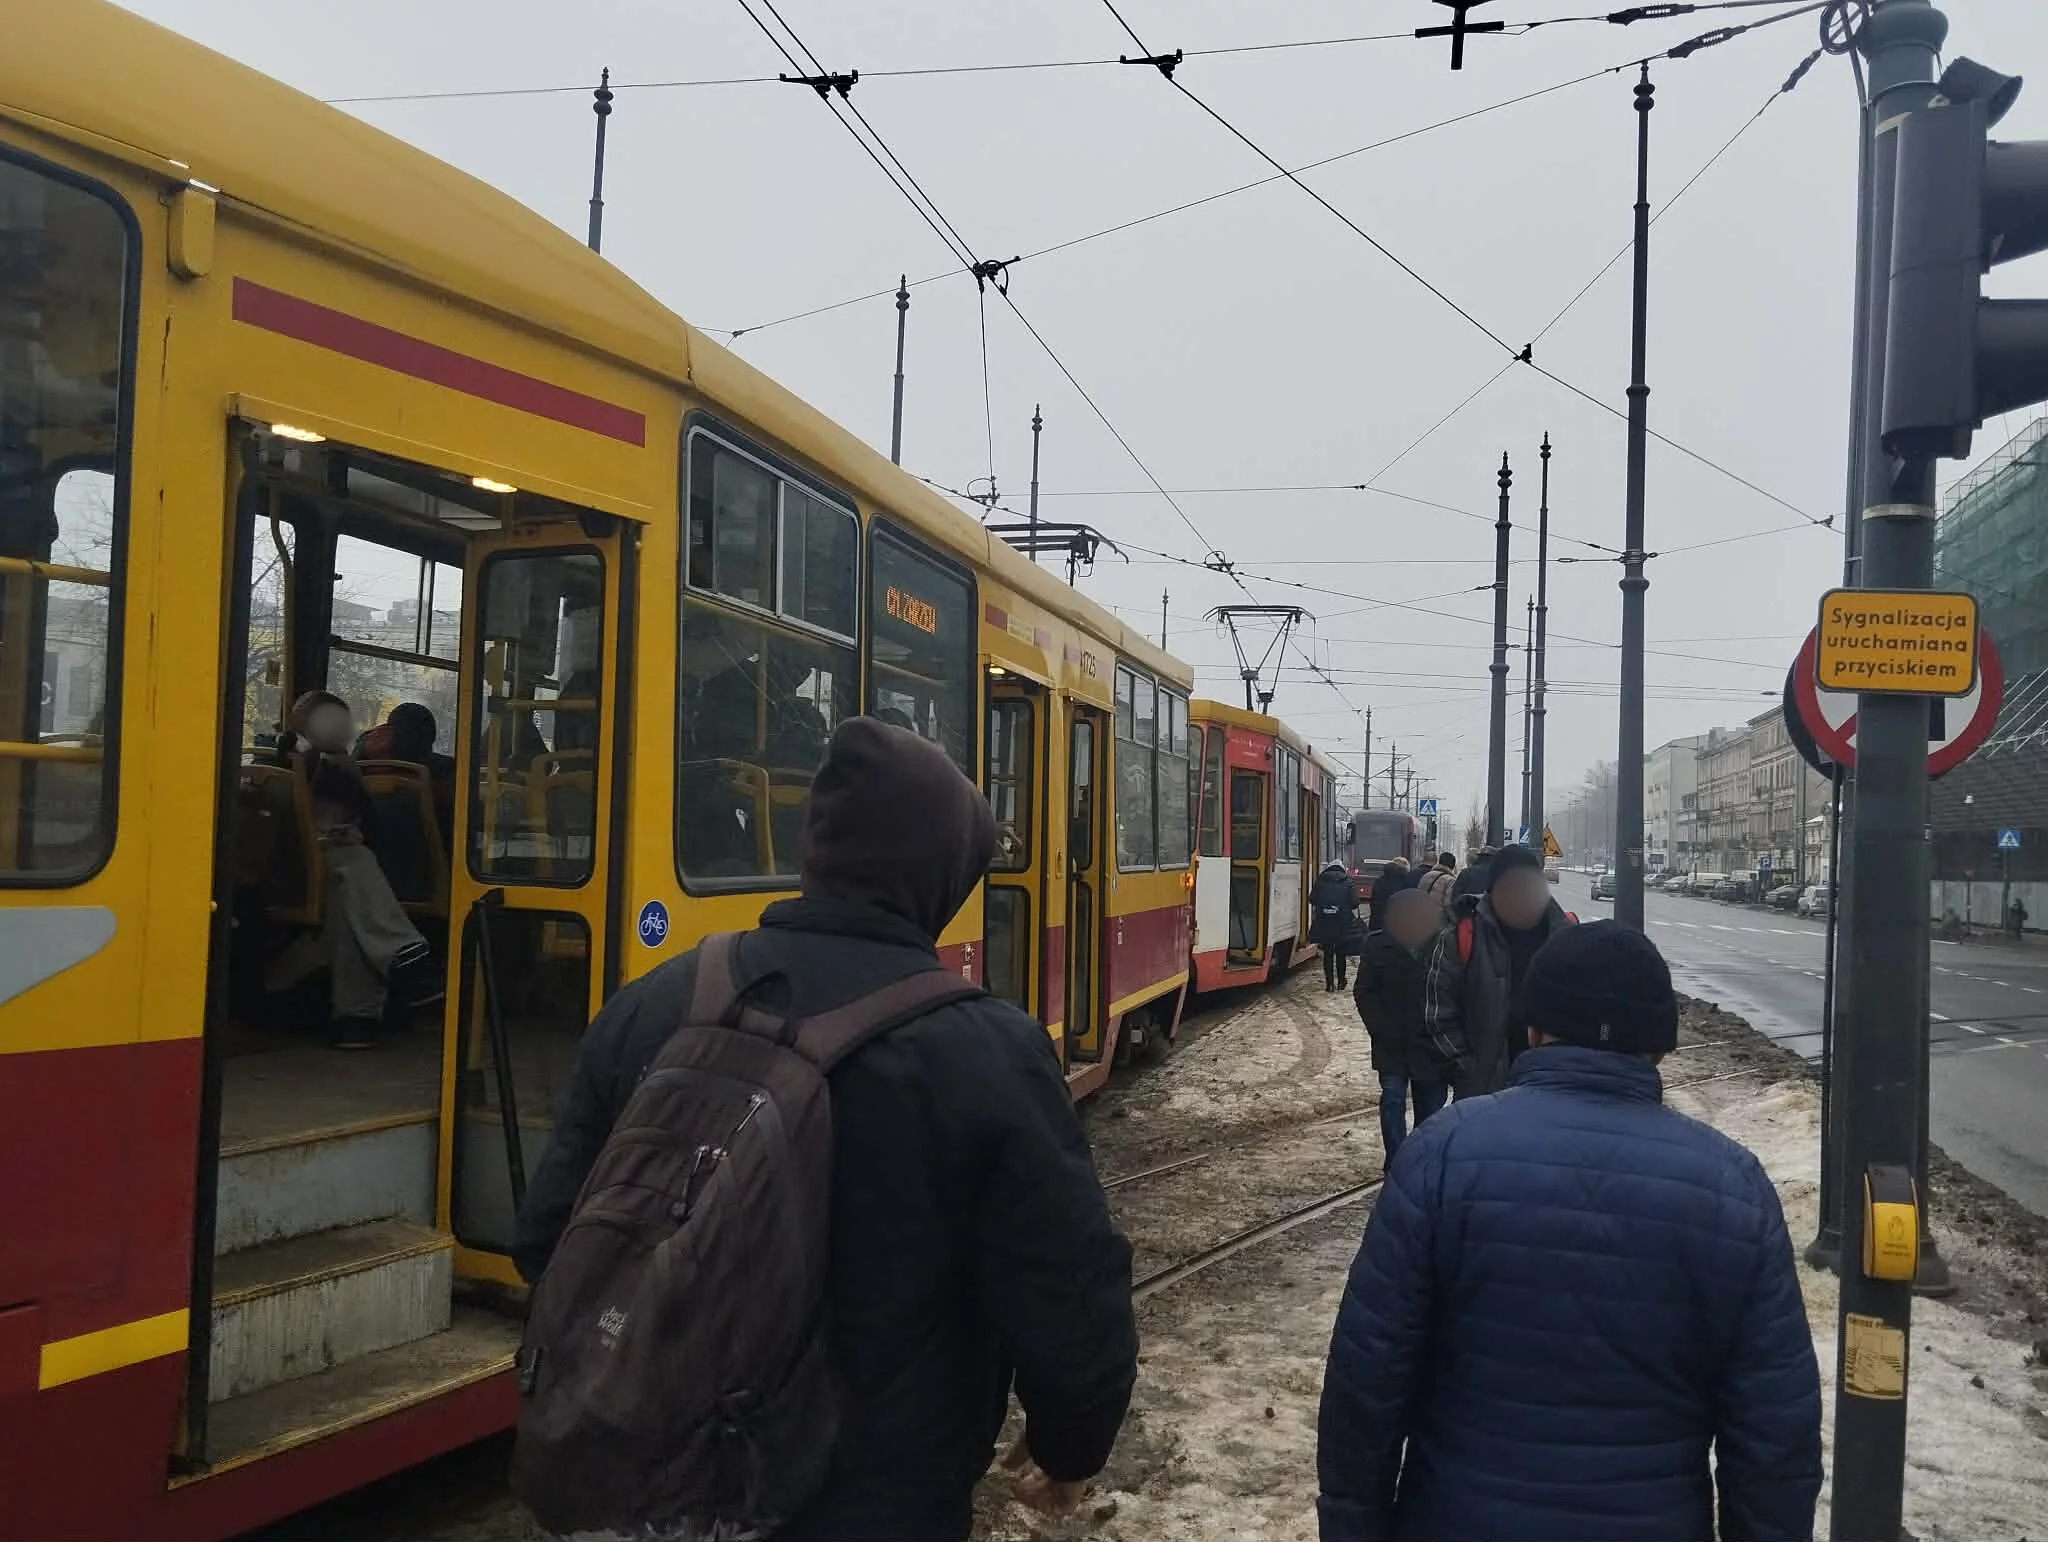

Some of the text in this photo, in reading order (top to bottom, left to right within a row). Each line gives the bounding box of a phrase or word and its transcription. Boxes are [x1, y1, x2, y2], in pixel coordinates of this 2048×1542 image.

[1831, 608, 1967, 631] Sygnalizacja
[1826, 634, 1968, 652] uruchamiana
[1834, 659, 1957, 677] przyciskiem
